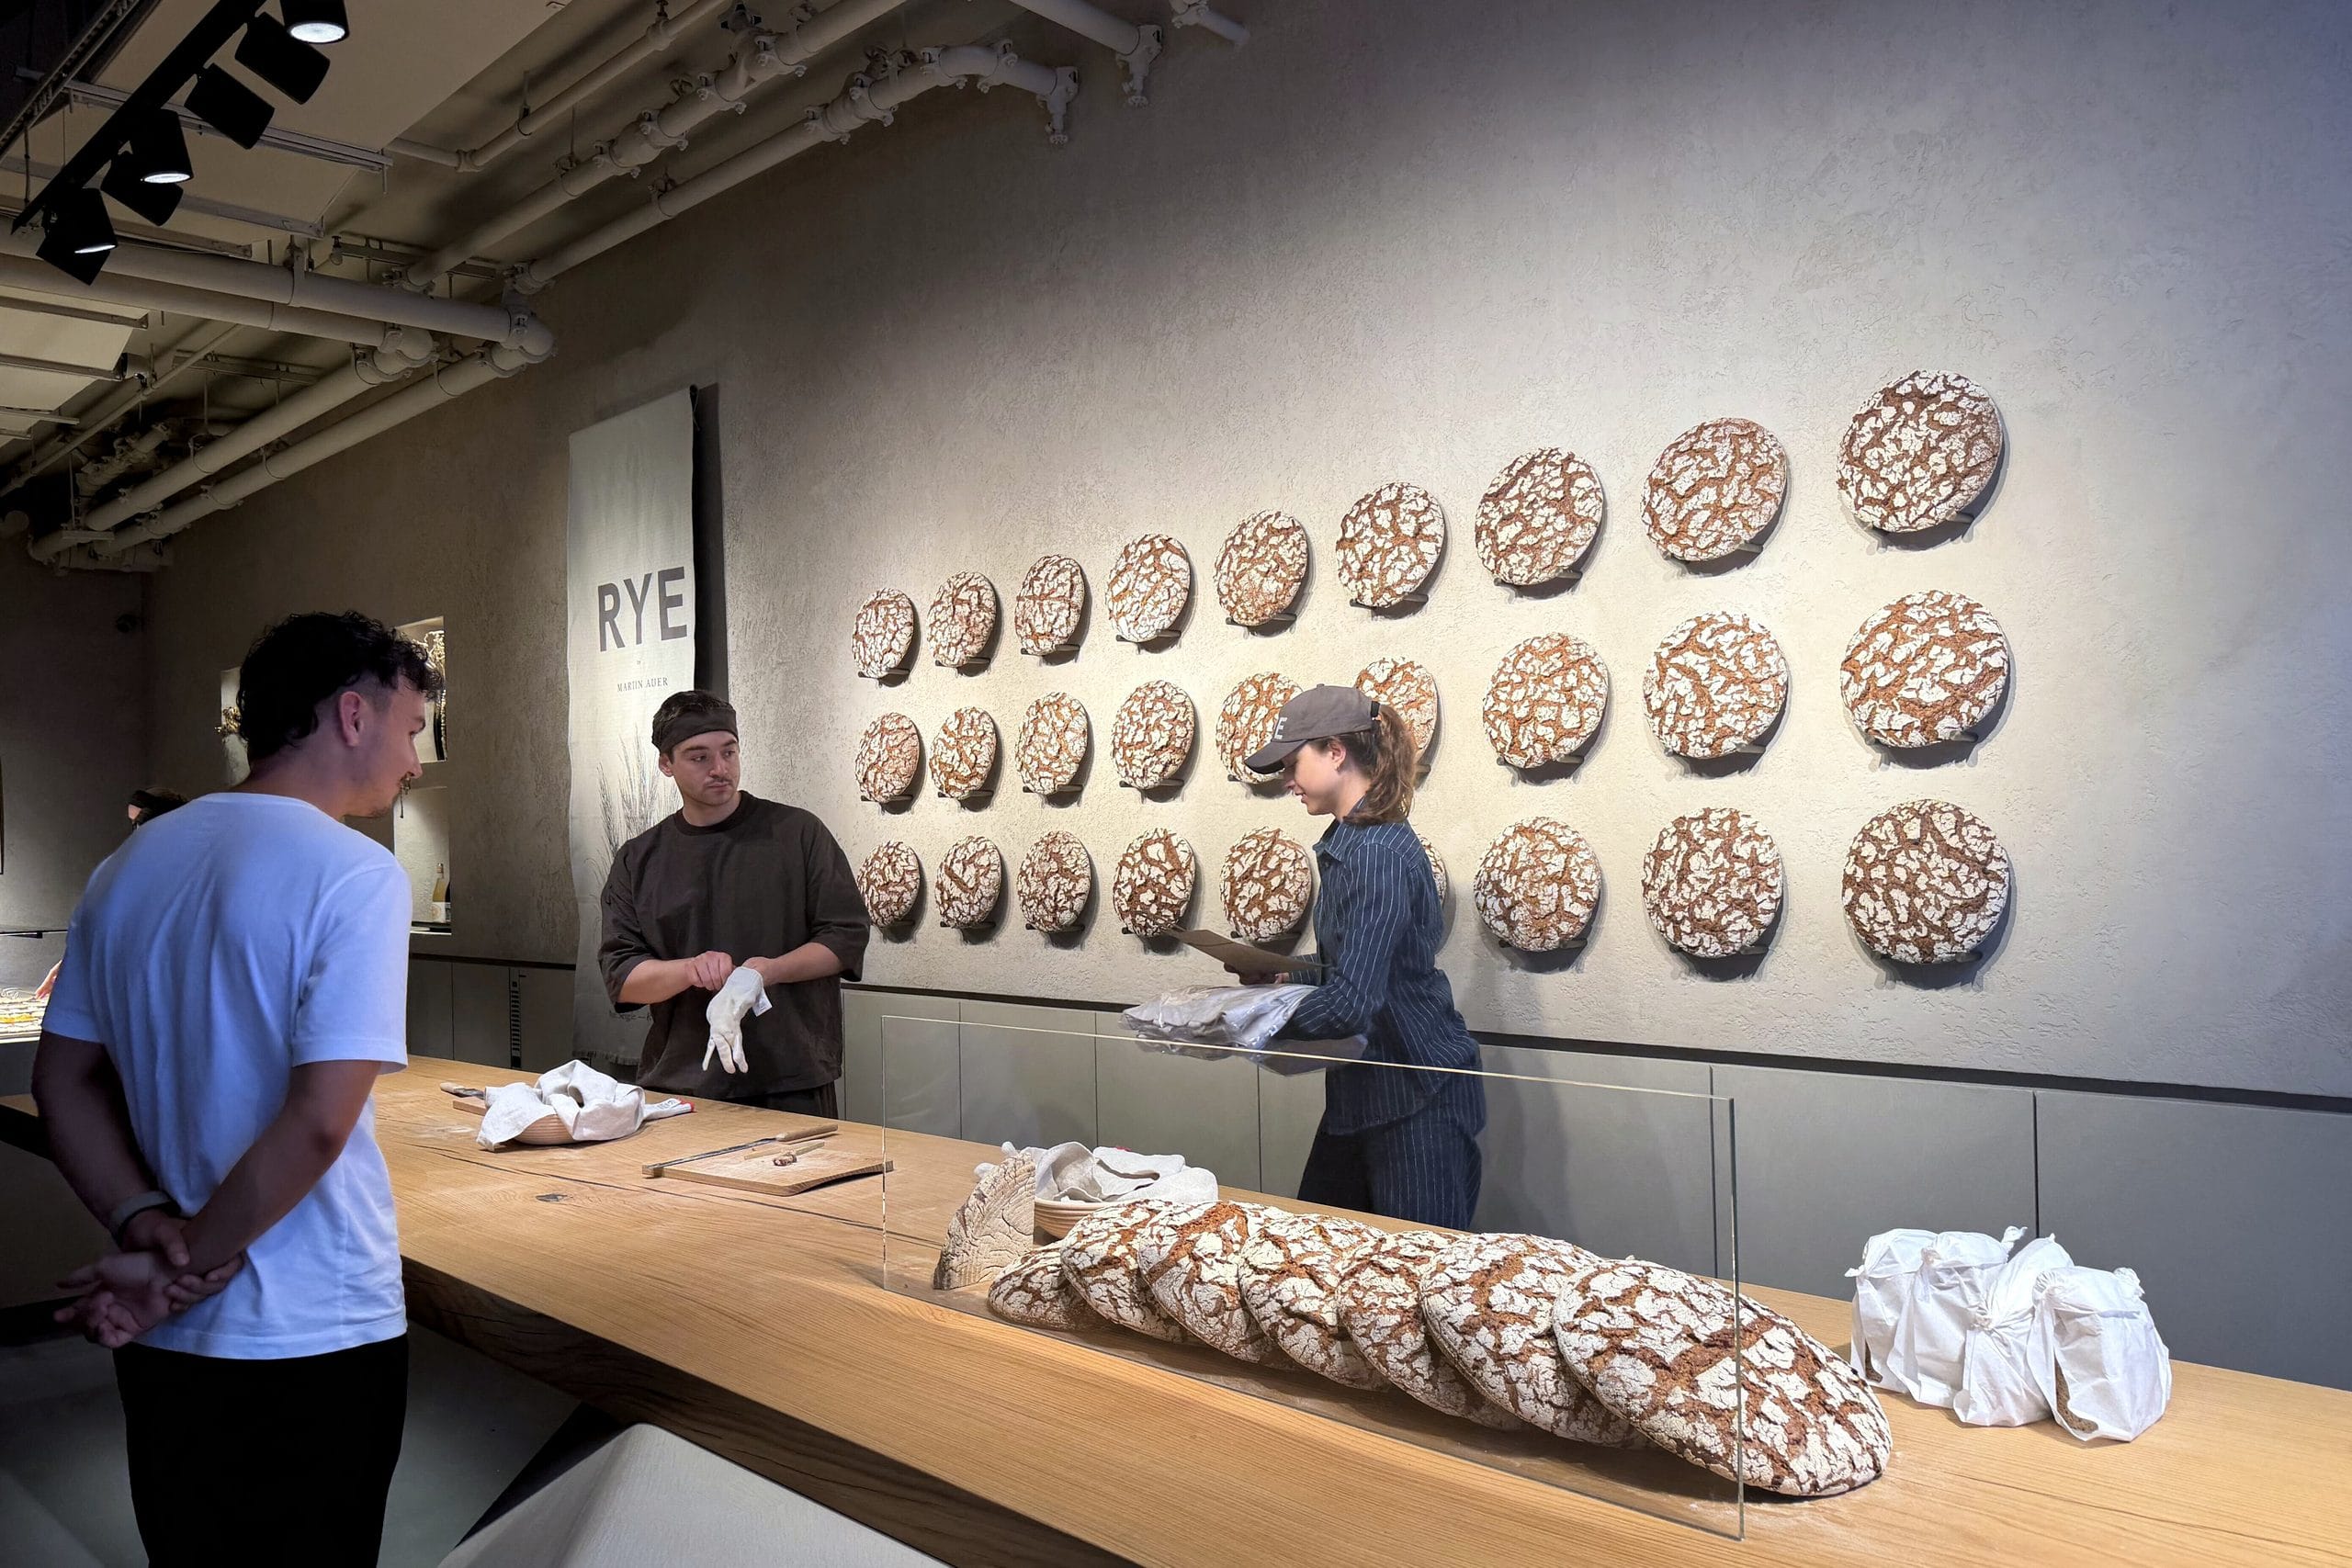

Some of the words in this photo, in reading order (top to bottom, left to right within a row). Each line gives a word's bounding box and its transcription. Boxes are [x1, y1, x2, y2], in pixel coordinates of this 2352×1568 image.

[598, 567, 687, 651] RYE
[617, 680, 643, 693] MARTIN
[646, 677, 669, 688] AUER
